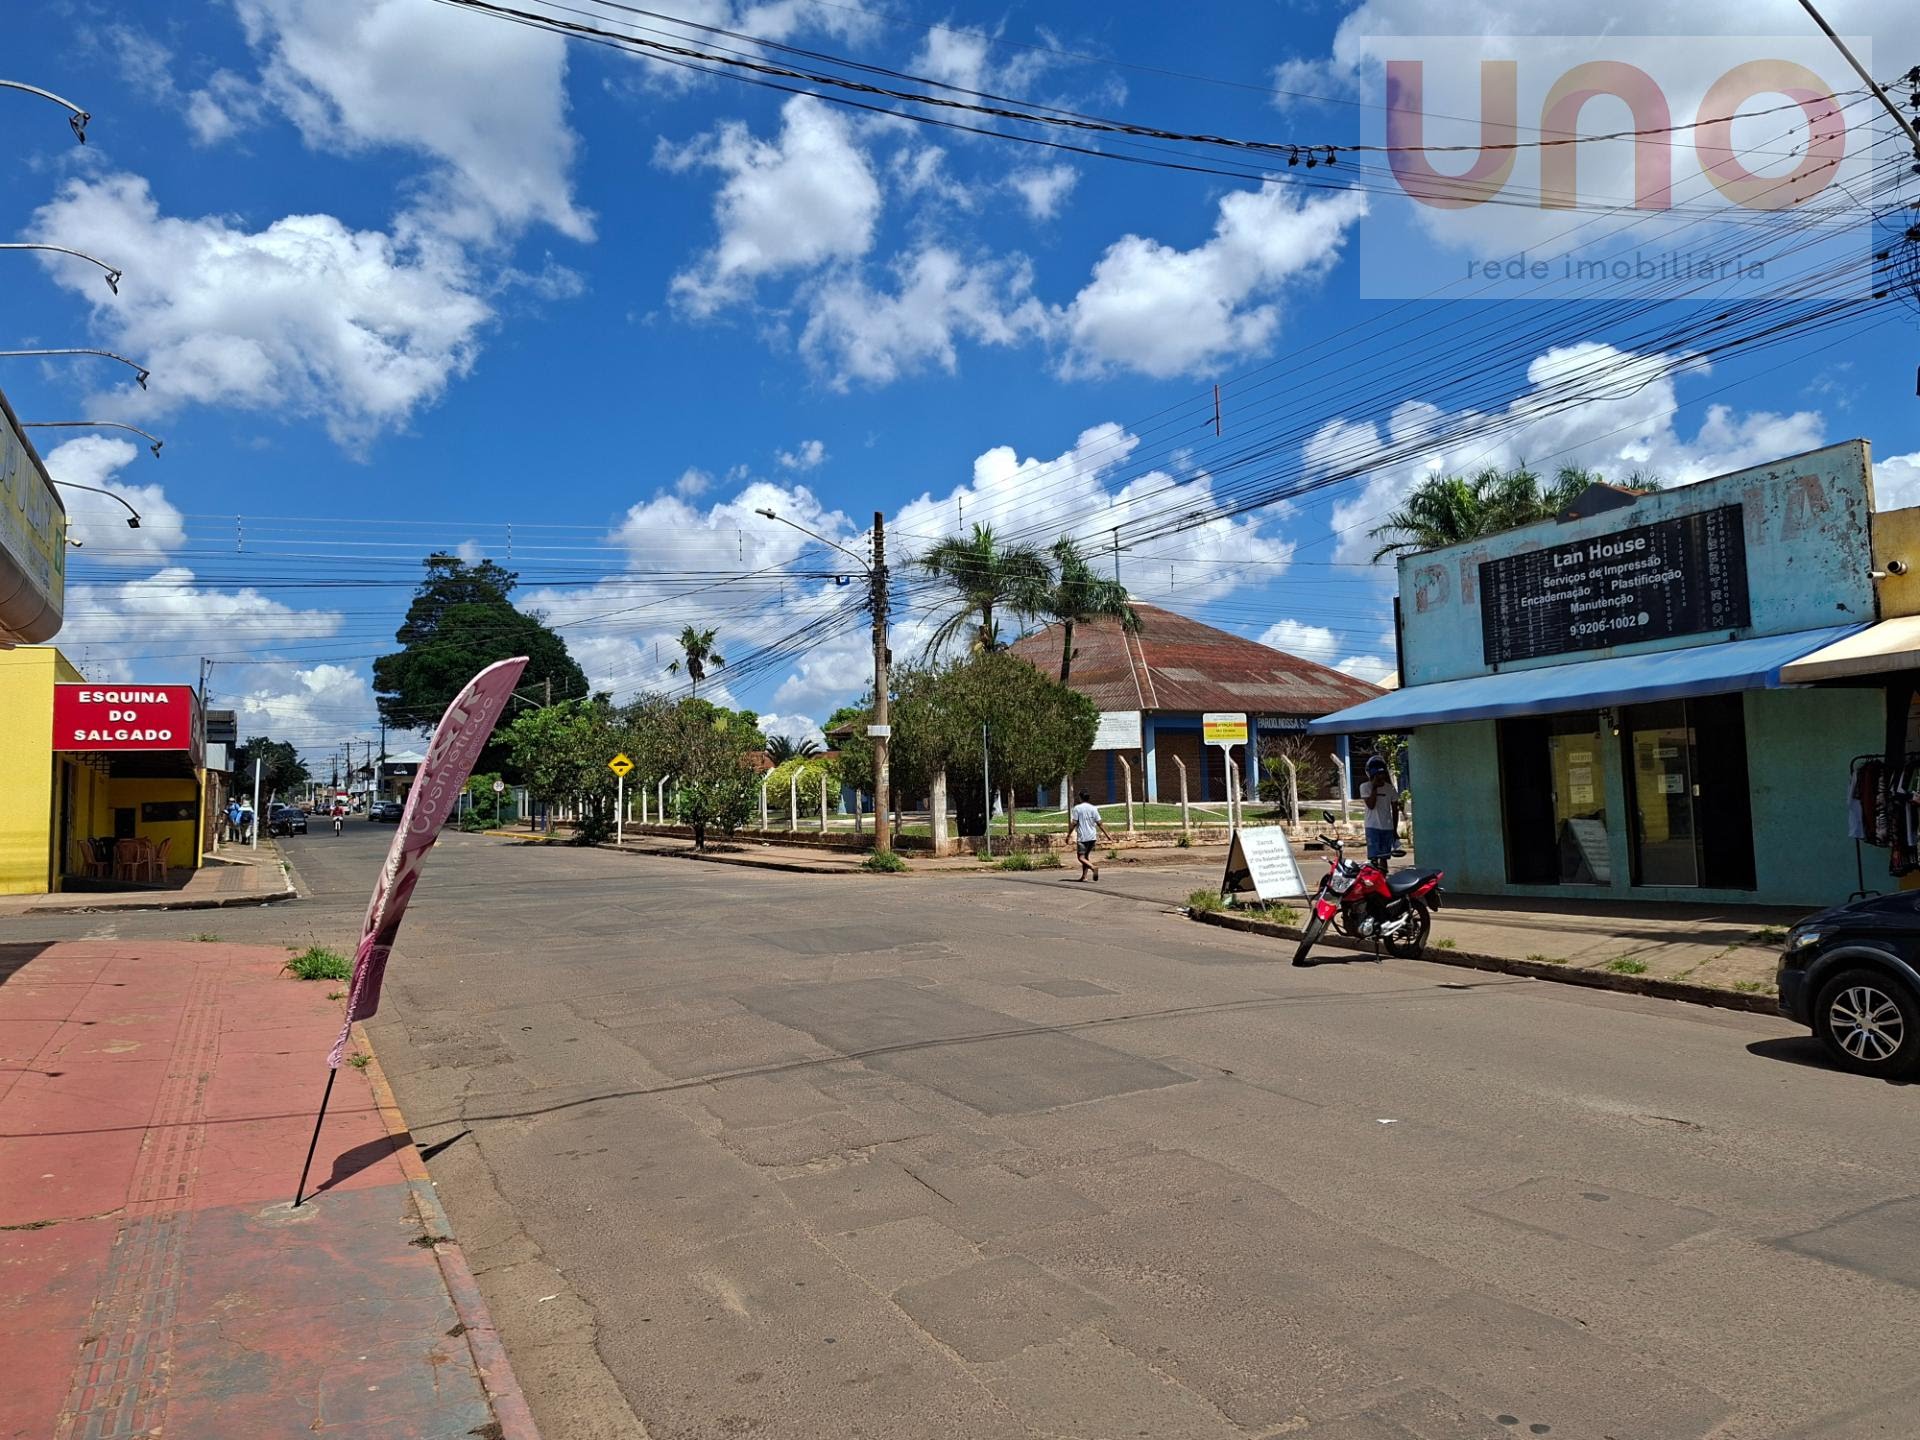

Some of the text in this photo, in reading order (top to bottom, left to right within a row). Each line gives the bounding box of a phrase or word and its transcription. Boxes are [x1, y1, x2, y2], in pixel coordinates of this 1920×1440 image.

[1553, 536, 1646, 568] Lan House
[1543, 556, 1662, 588] Serviços de Impressão
[1521, 568, 1682, 607] Encadernação Plastificação
[1570, 594, 1634, 614] Manutenção
[1569, 615, 1636, 637] 9 9206-1002
[78, 691, 169, 704] ESQUINA
[108, 710, 137, 722] DO
[73, 729, 173, 742] SALGADO
